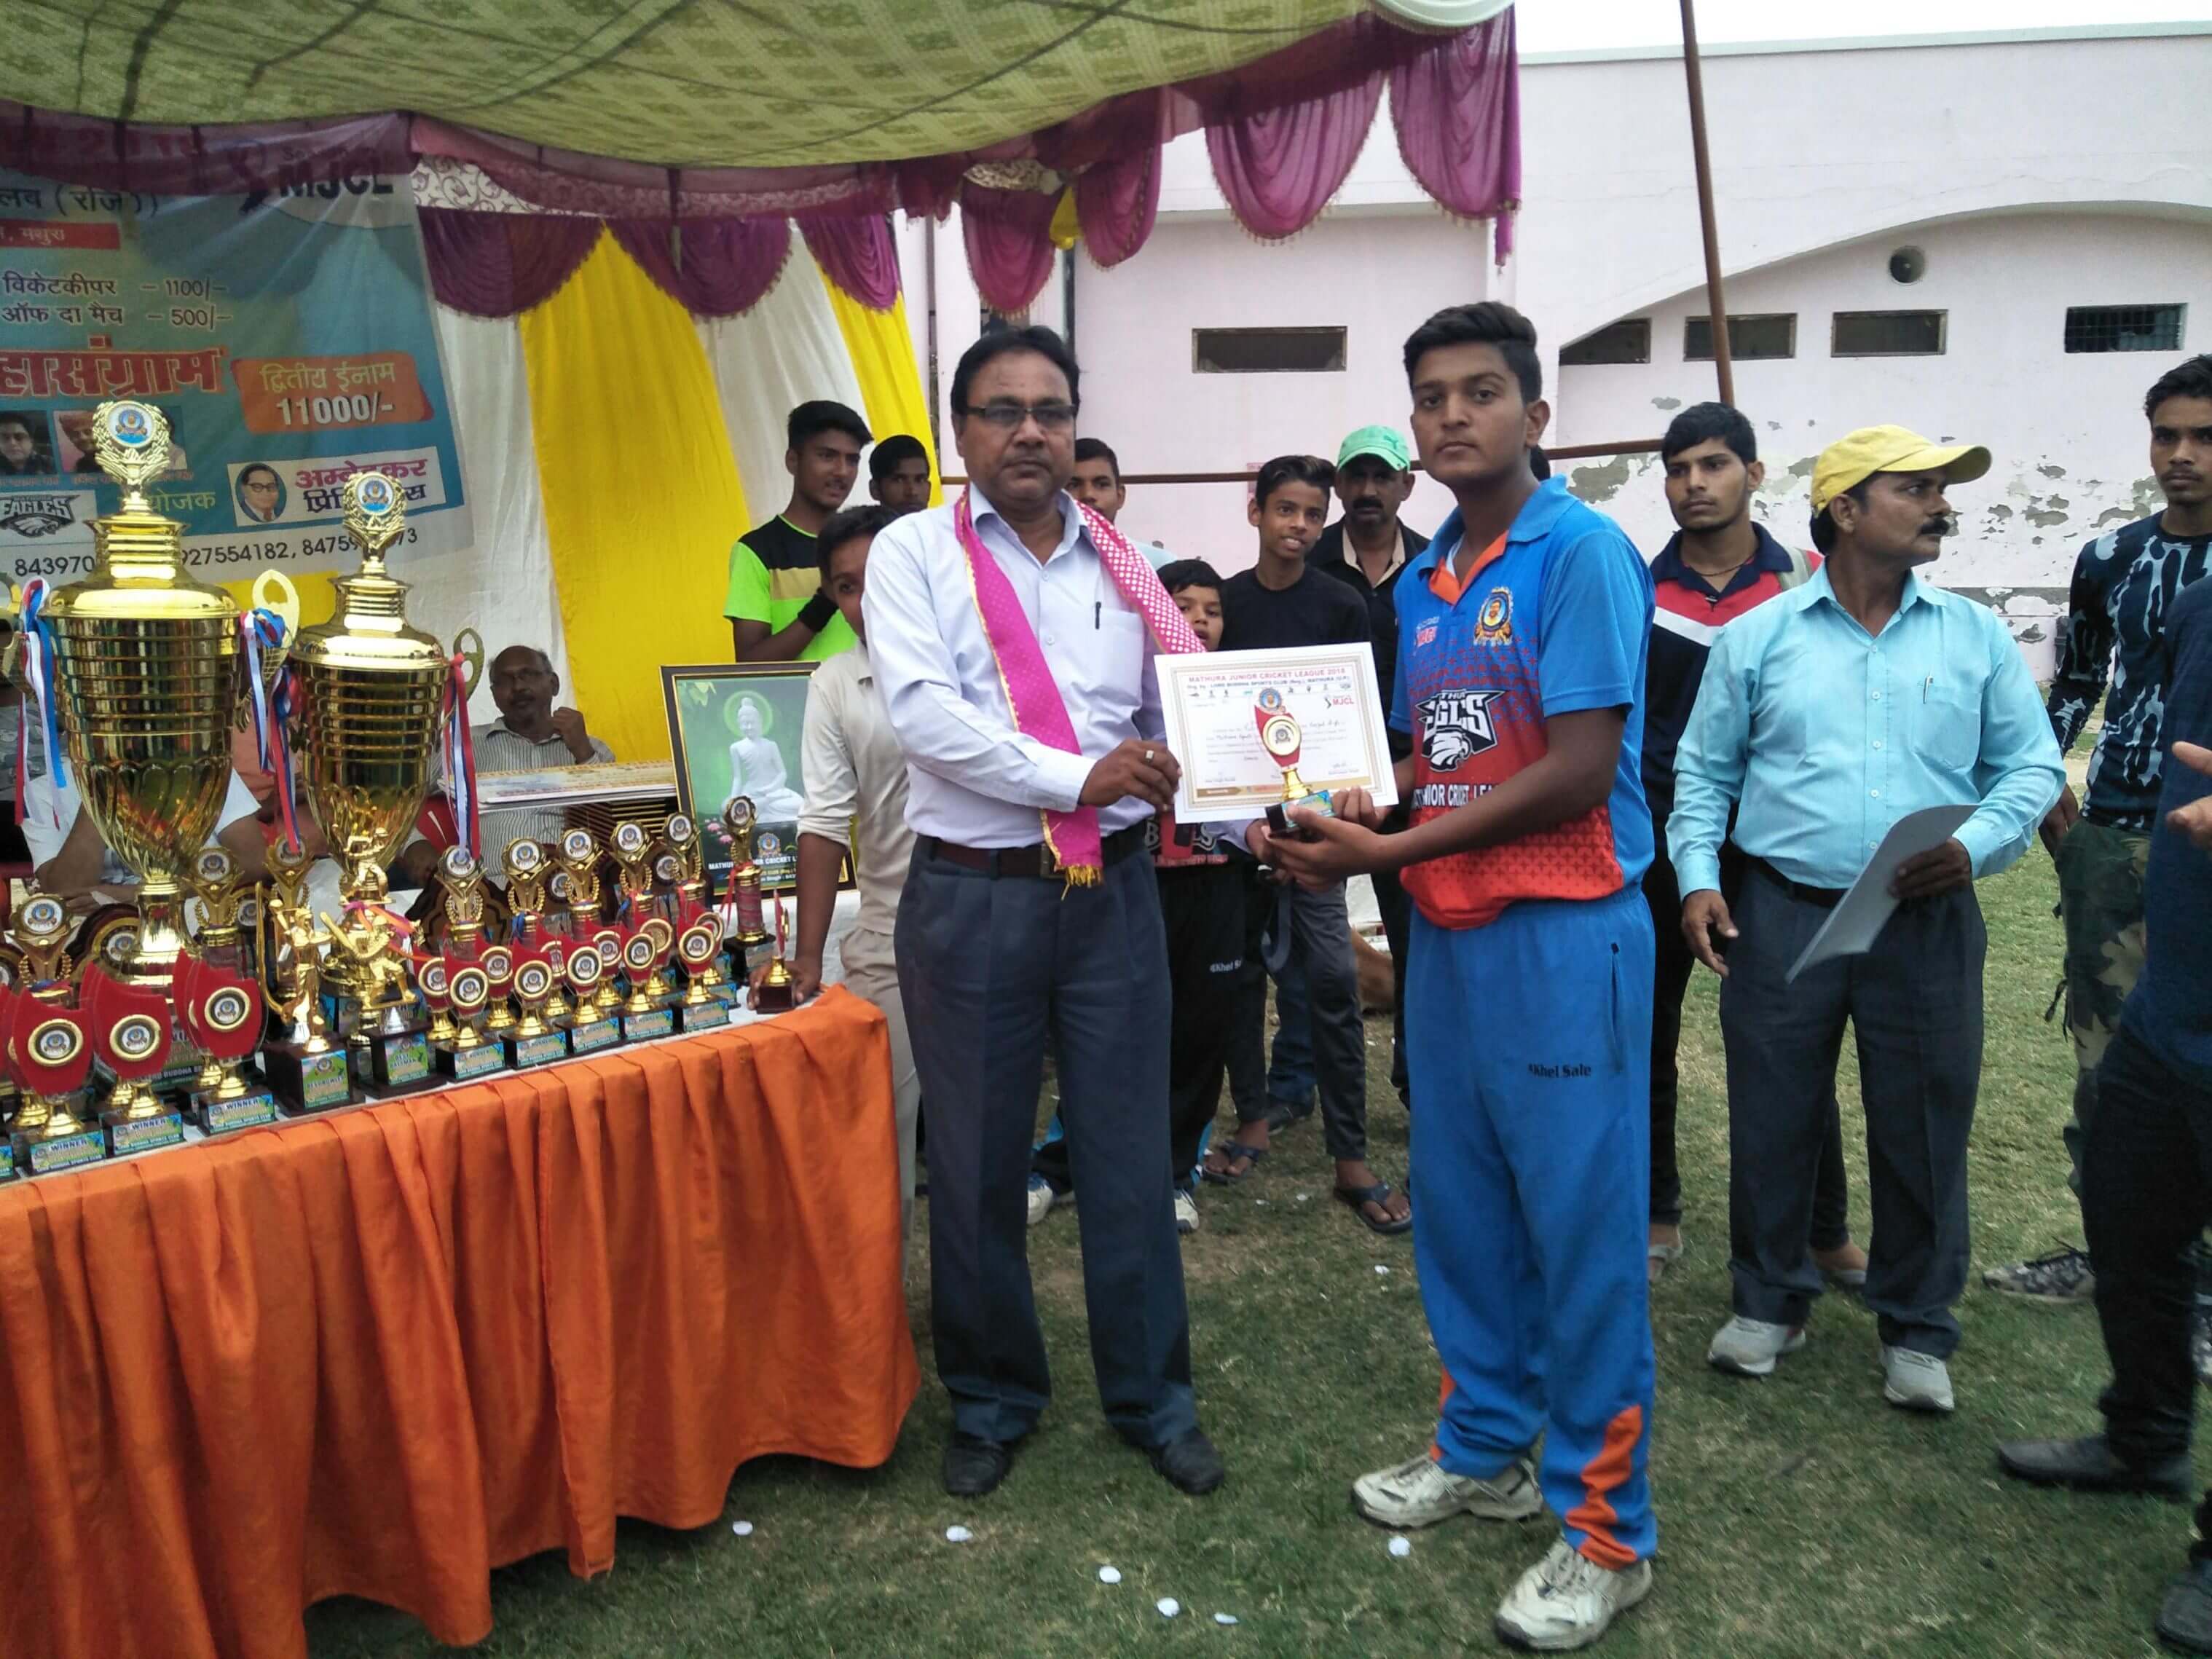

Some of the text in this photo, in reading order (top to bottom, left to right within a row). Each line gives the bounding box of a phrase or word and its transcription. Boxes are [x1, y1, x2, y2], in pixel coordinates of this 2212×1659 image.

[3, 269, 117, 295] विकेटकीपर
[88, 301, 123, 323] मैच
[0, 334, 225, 398] हासंग्राम
[275, 391, 396, 426] 11000/-
[1189, 675, 1227, 683] MATHURA
[1229, 673, 1258, 681] JUNIOR
[1259, 671, 1292, 679] CRICKET
[1294, 669, 1325, 677] LEAGUE
[226, 1098, 260, 1110] WINNER
[131, 1118, 166, 1131] WINNER
[50, 1138, 88, 1151] WINNER
